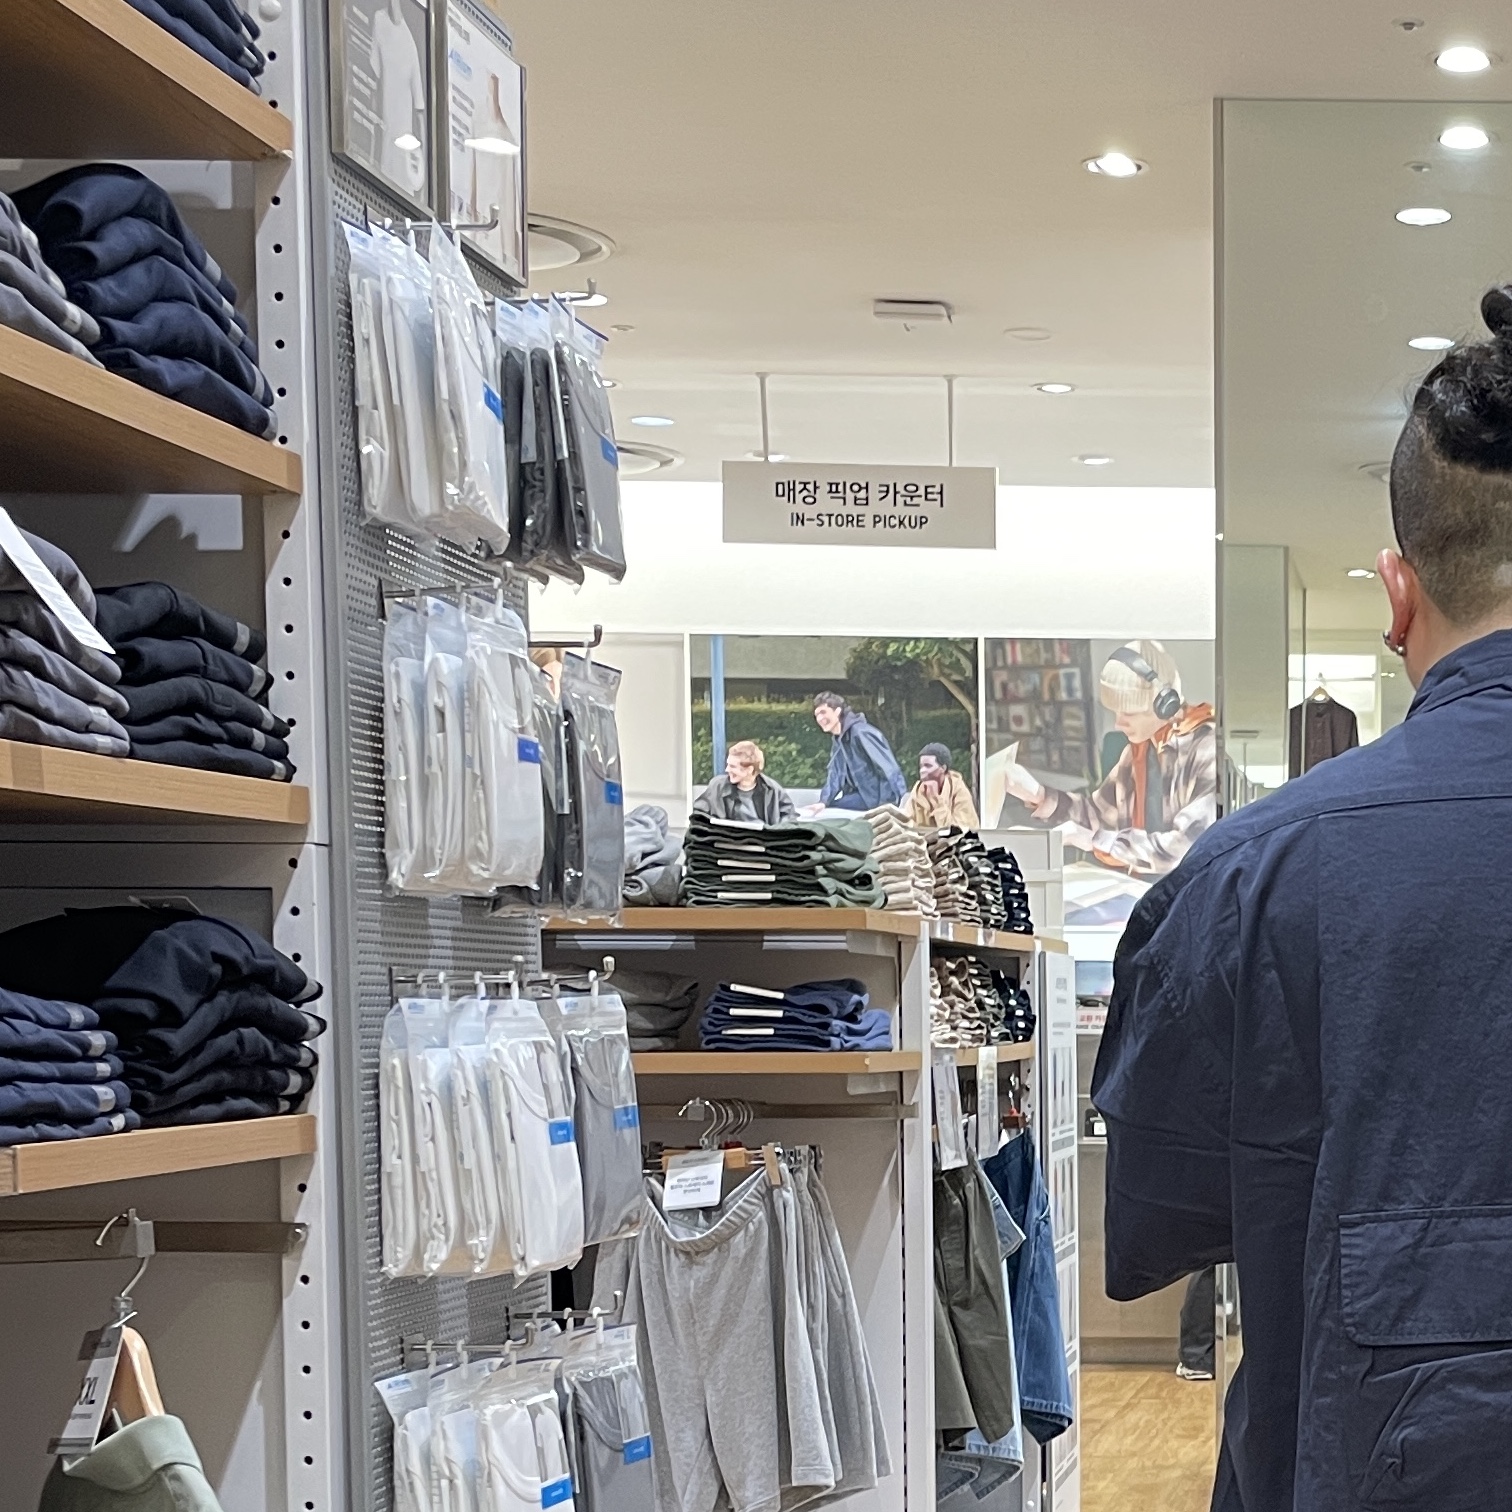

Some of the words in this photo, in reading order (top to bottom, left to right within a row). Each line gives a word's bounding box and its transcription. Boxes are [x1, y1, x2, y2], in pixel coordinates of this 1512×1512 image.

[775, 480, 820, 506] 매장
[826, 481, 870, 506] 픽업
[877, 482, 945, 508] 카운터
[790, 512, 866, 529] IN-STORE
[872, 514, 929, 530] PICKUP
